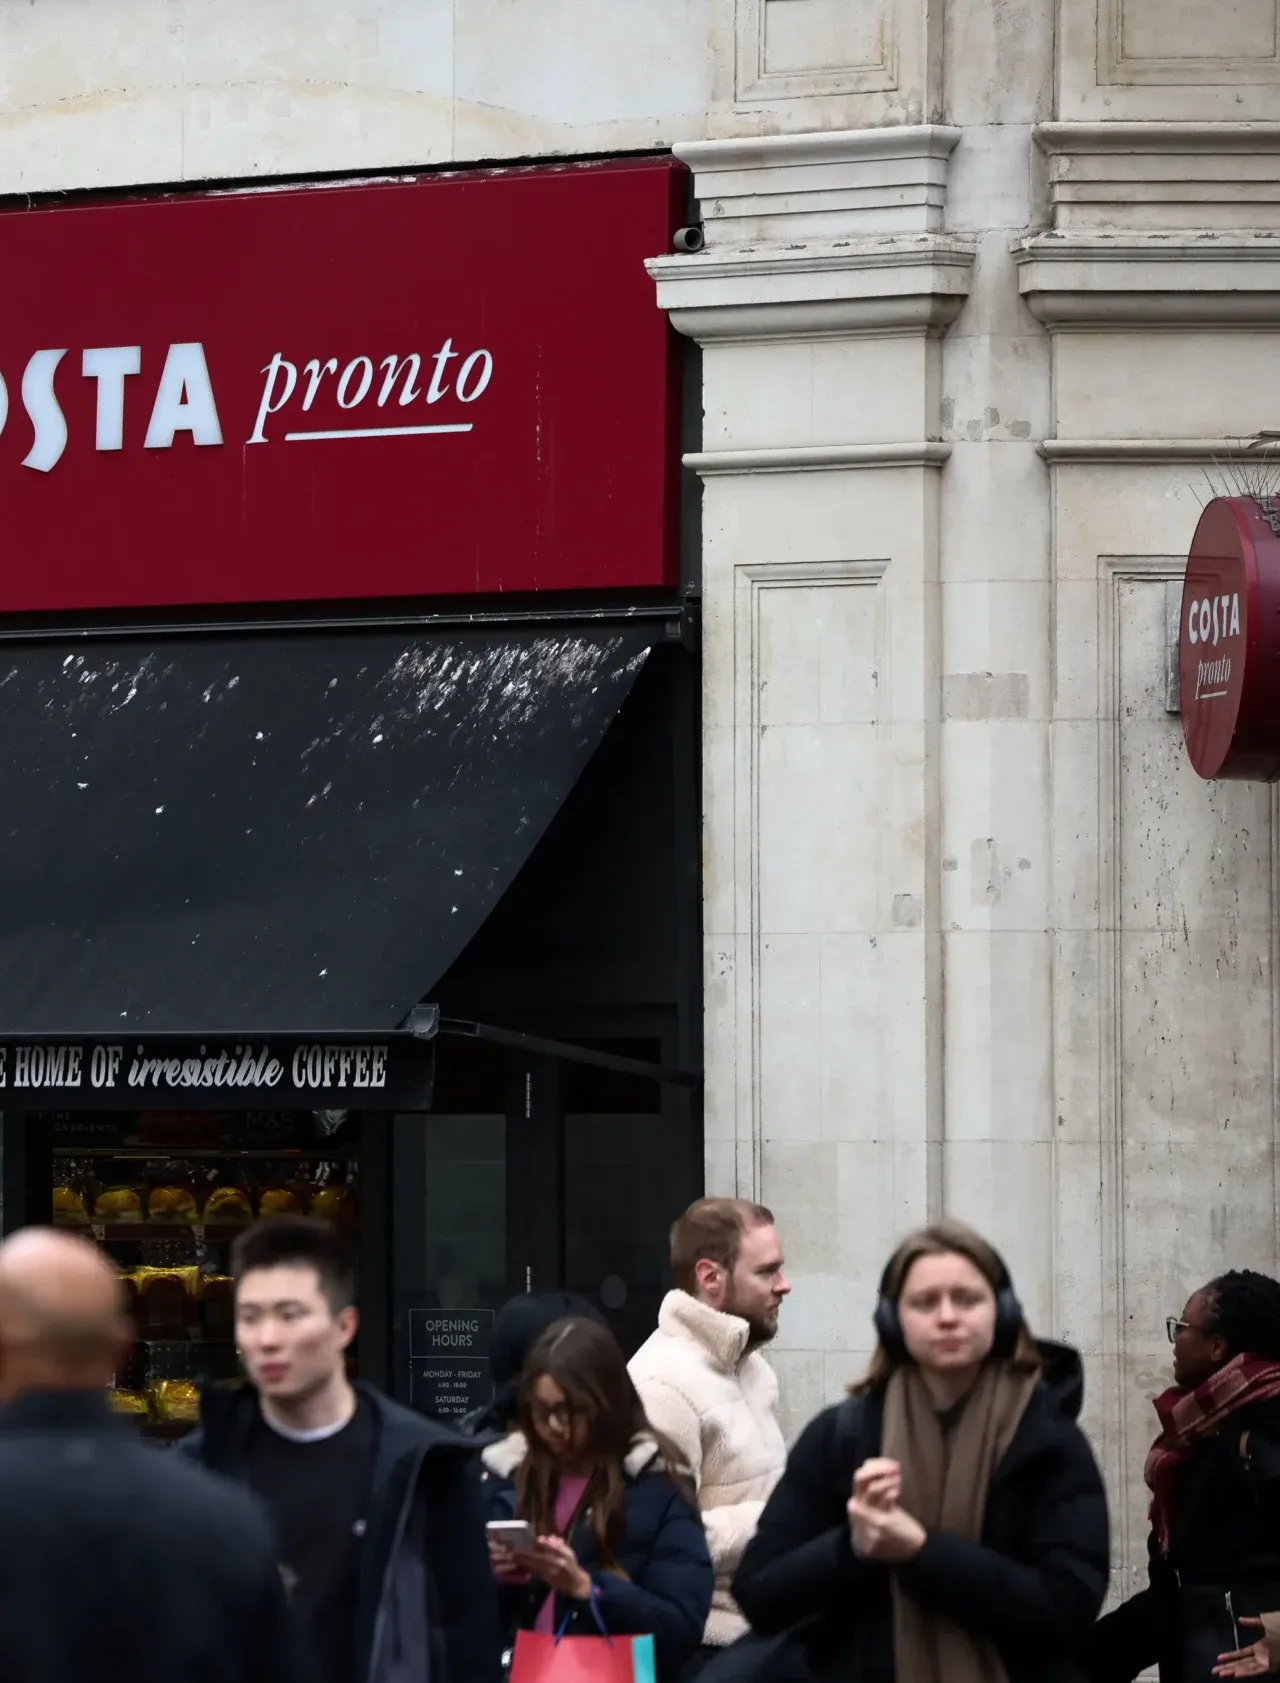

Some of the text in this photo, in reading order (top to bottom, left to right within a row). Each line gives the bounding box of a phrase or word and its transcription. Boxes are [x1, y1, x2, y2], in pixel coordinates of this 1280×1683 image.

[246, 337, 493, 445] pronto
[1188, 592, 1240, 647] COSTA
[1194, 654, 1232, 701] pronto
[14, 1045, 83, 1088] HOME
[91, 1044, 123, 1088] OF
[128, 1044, 284, 1088] irresistible
[292, 1044, 389, 1088] COFFEE
[425, 1319, 479, 1332] OPENING
[432, 1334, 473, 1347] HOURS
[422, 1370, 452, 1378] MONDAY
[458, 1370, 482, 1379] FRIDAY
[435, 1395, 470, 1404] SATURDAY
